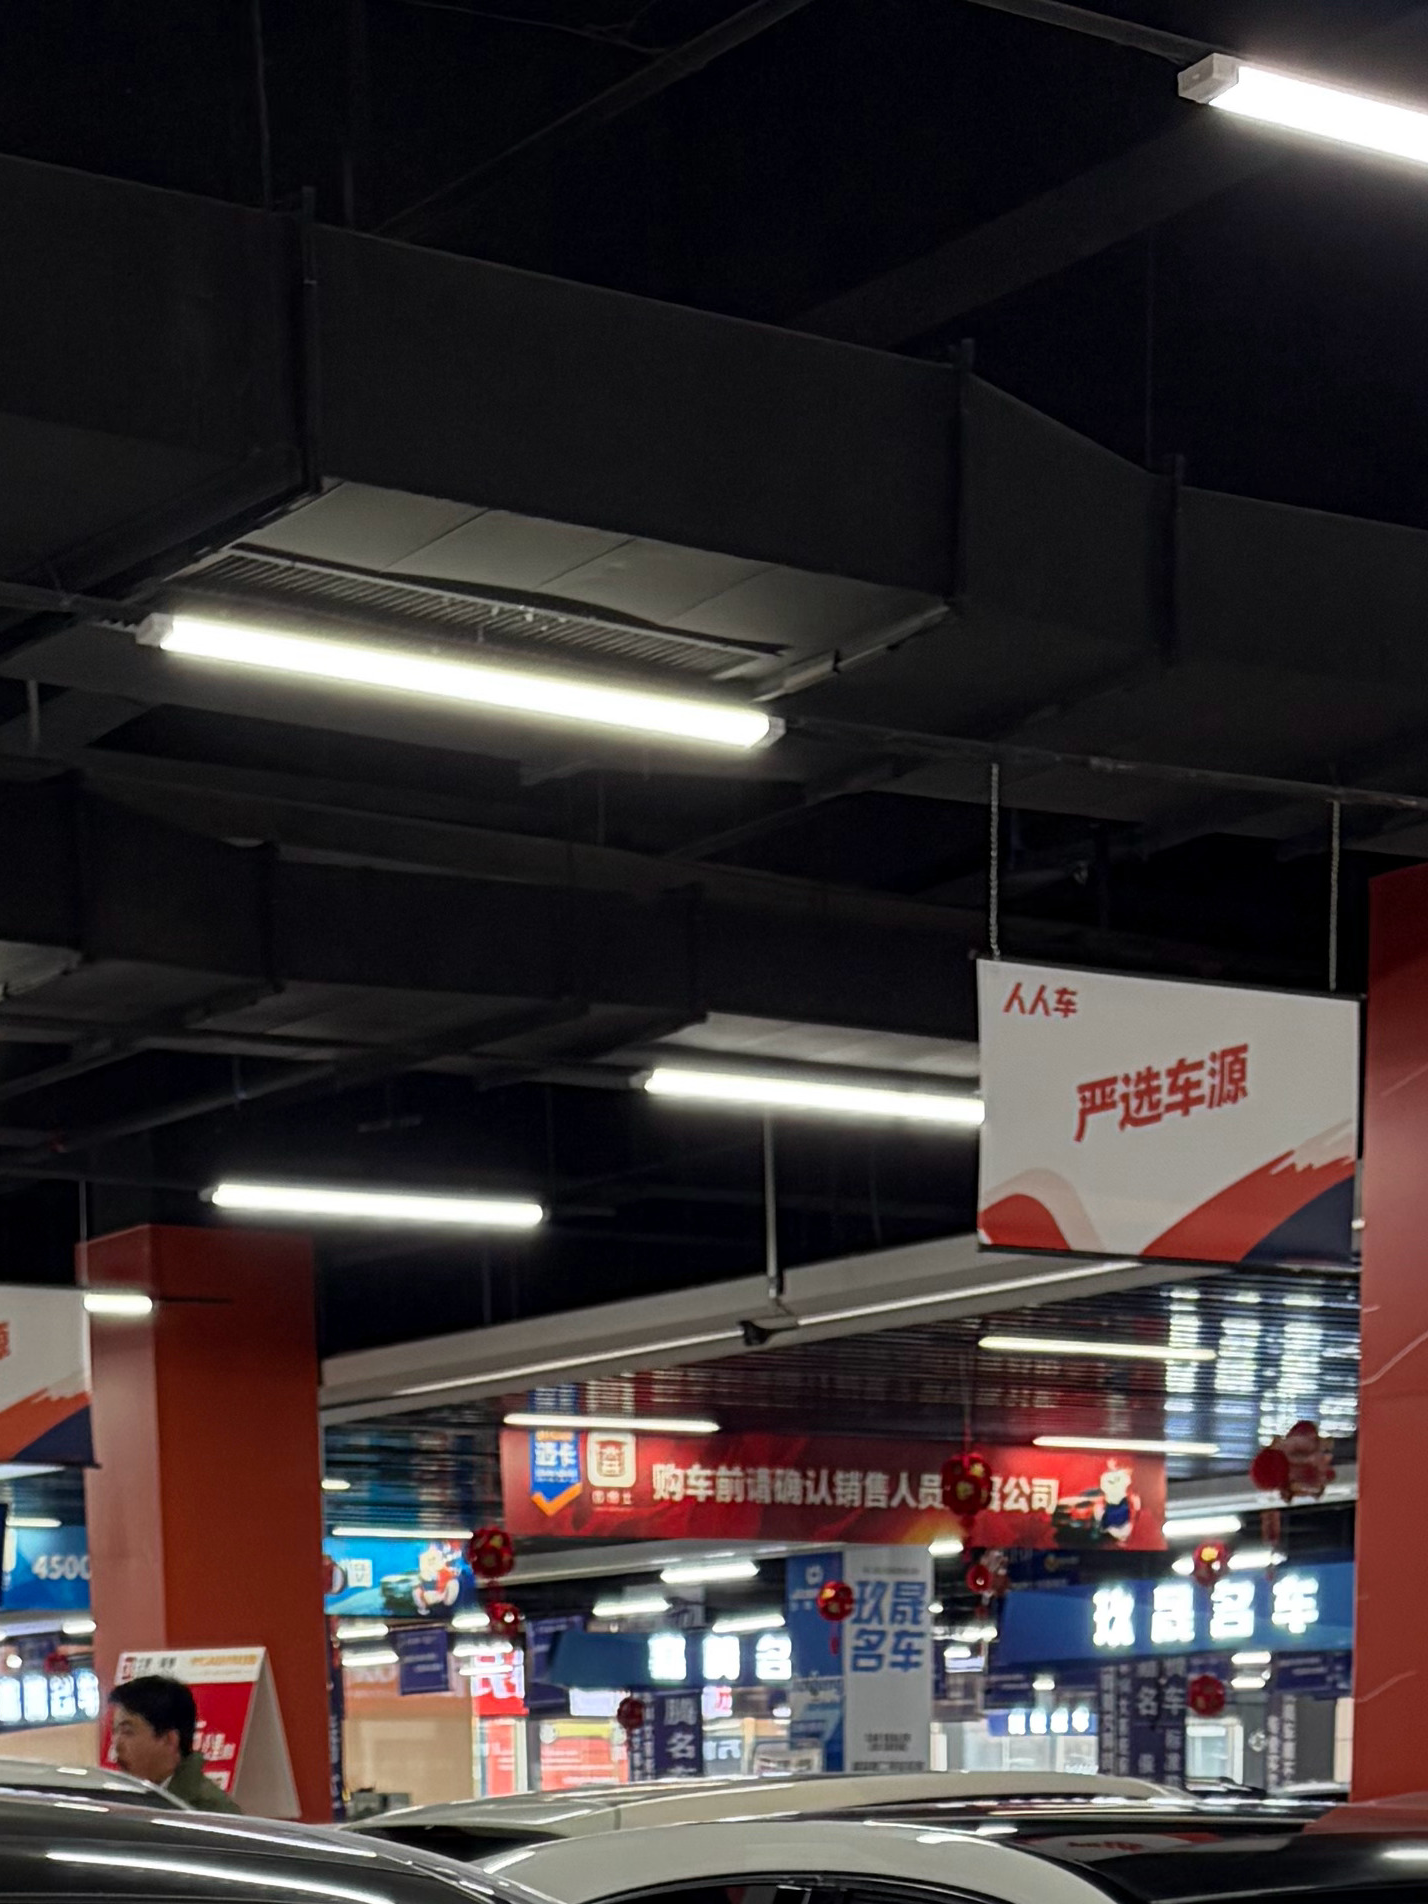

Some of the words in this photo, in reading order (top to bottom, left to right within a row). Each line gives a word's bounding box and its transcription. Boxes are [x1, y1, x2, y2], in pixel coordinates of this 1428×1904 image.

[1003, 982, 1078, 1018] 人人车
[1075, 1043, 1248, 1142] 严选车源
[652, 1463, 1059, 1514] 购车前请确认销售人员公司
[852, 1629, 924, 1672] 名车
